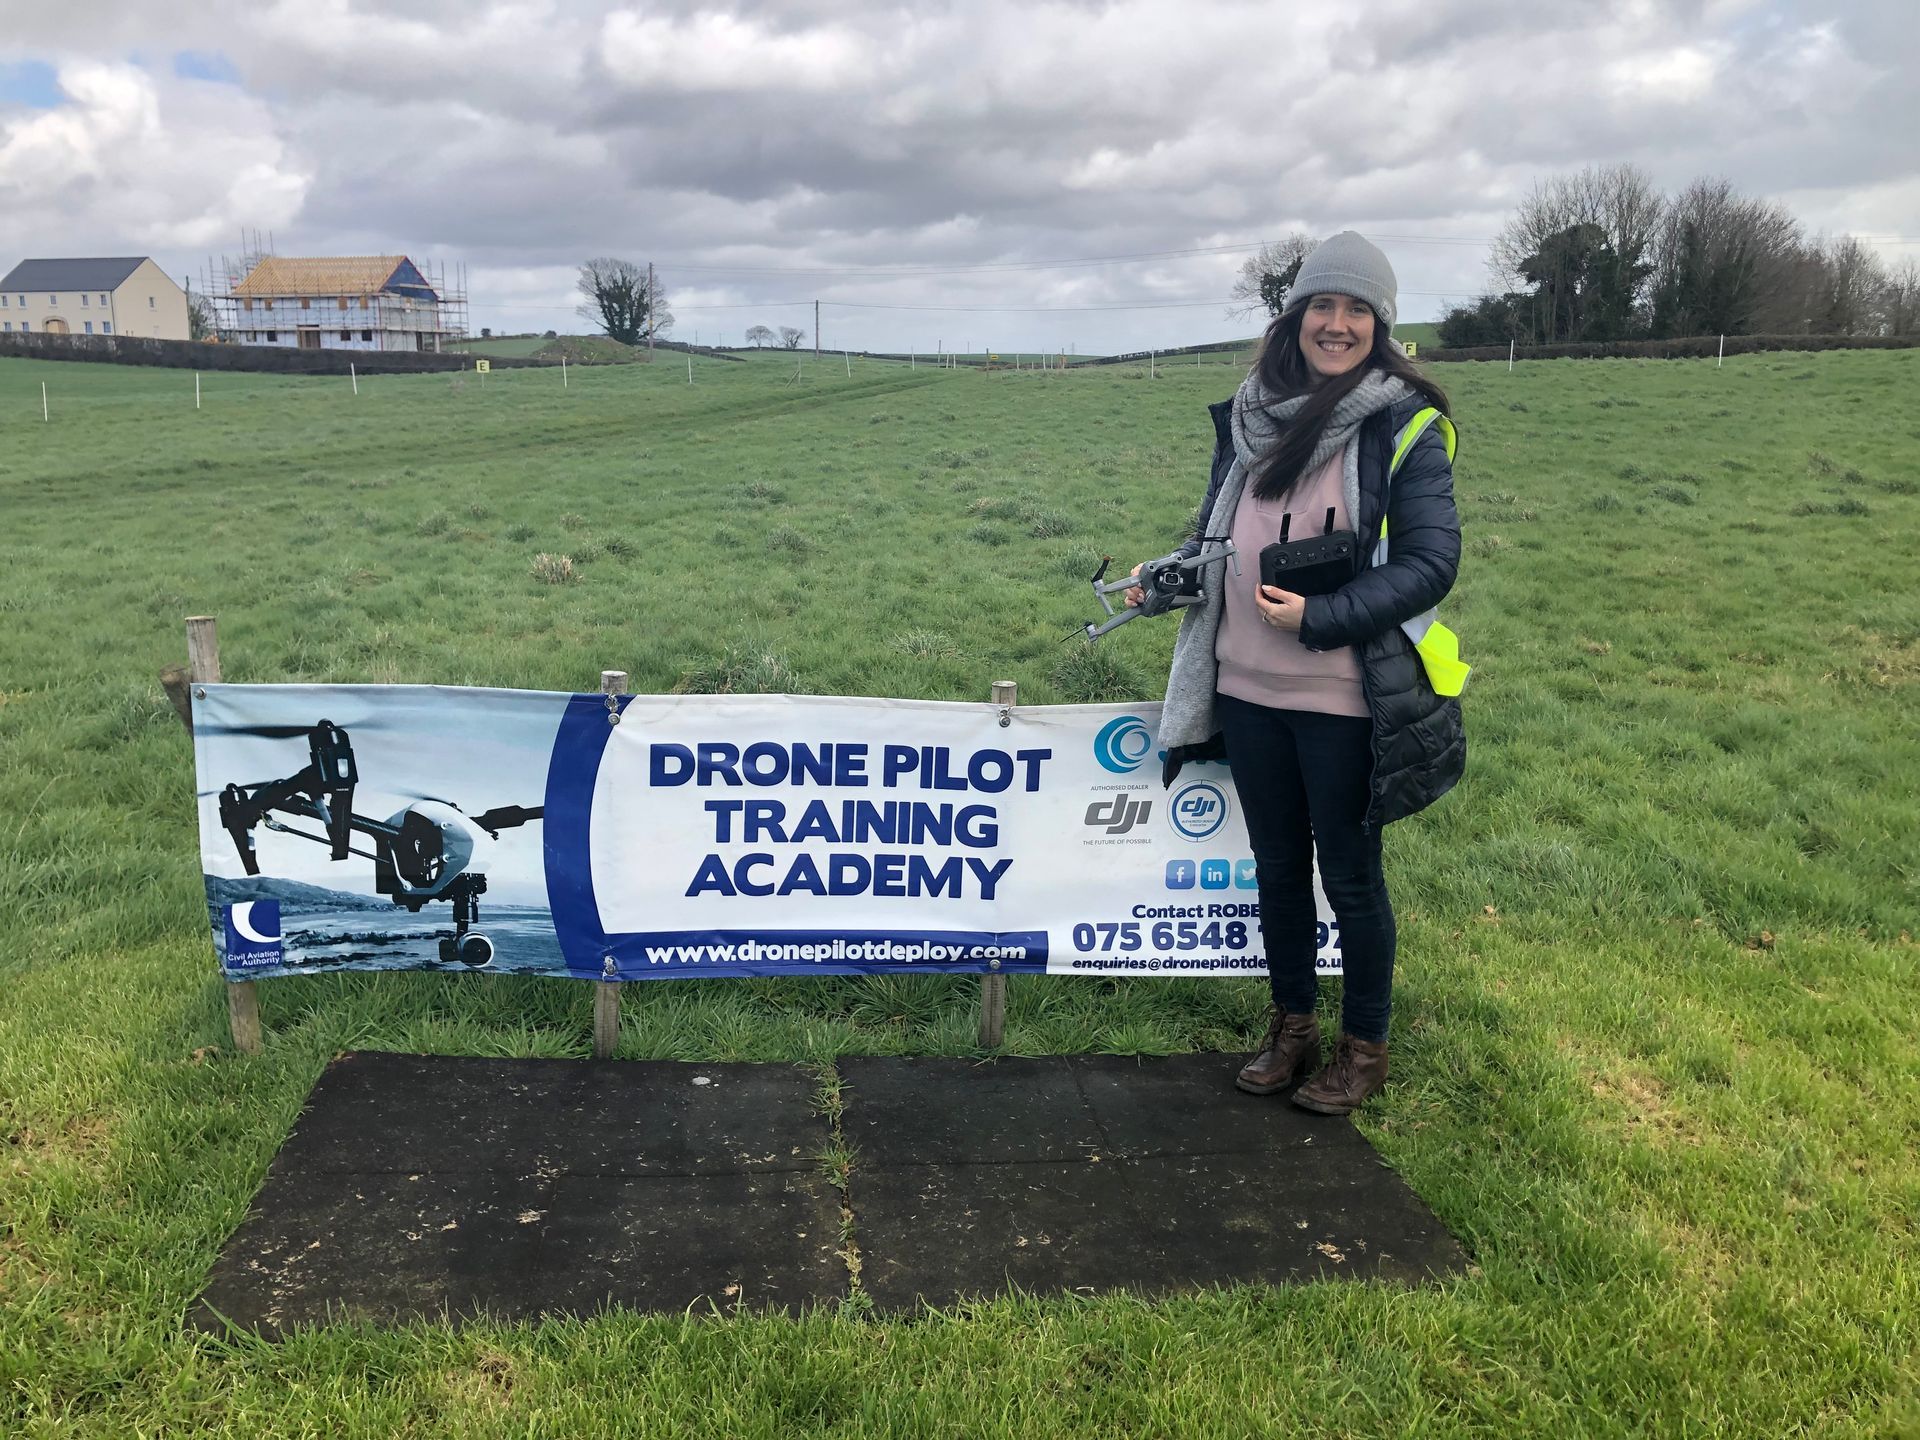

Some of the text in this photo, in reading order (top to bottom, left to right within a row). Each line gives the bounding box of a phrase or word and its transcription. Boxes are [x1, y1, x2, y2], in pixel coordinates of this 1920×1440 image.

[1406, 344, 1413, 354] F
[479, 362, 487, 371] E
[649, 741, 1052, 793] DRONE PILOT
[704, 799, 999, 848] TRAINING
[684, 853, 1014, 900] ACADEMY
[1207, 867, 1223, 882] in
[1131, 903, 1260, 919] Contact ROBE
[1072, 921, 1142, 952] 075
[1151, 920, 1249, 951] 6548
[247, 951, 280, 960] Aviation
[645, 939, 1027, 964] www.dronepilotdeploy.com
[241, 957, 280, 966] Authority
